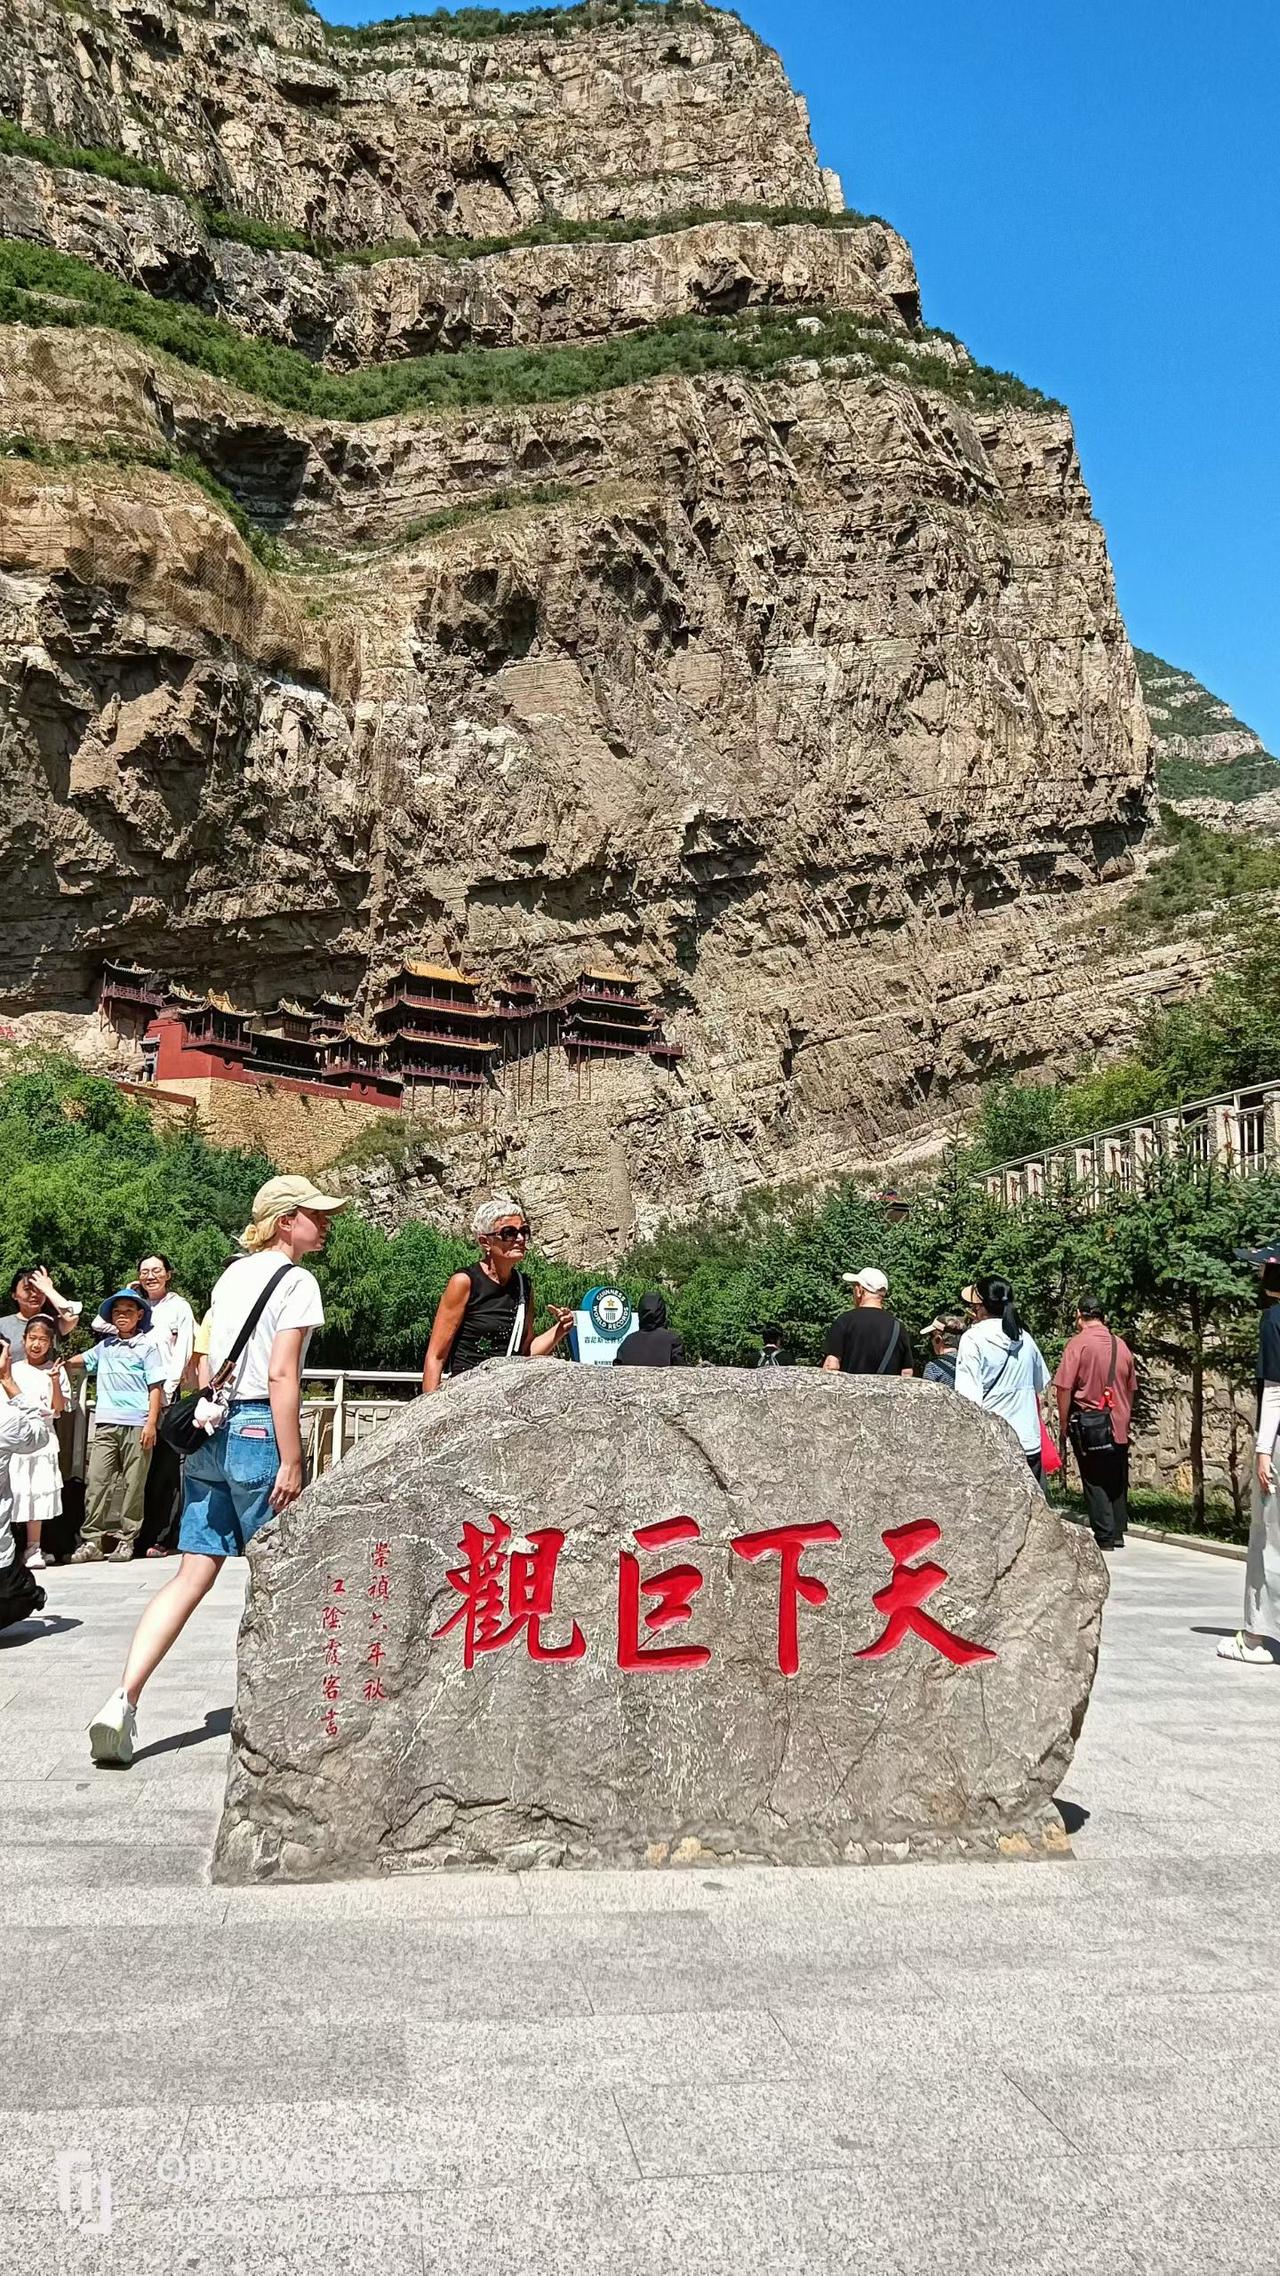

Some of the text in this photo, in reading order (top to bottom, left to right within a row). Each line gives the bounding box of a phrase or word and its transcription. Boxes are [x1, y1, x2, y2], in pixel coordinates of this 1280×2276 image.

[596, 1288, 626, 1302] GUINNESS
[593, 1306, 629, 1331] WORLD RECORDS
[432, 1514, 998, 1676] 天下巨觀
